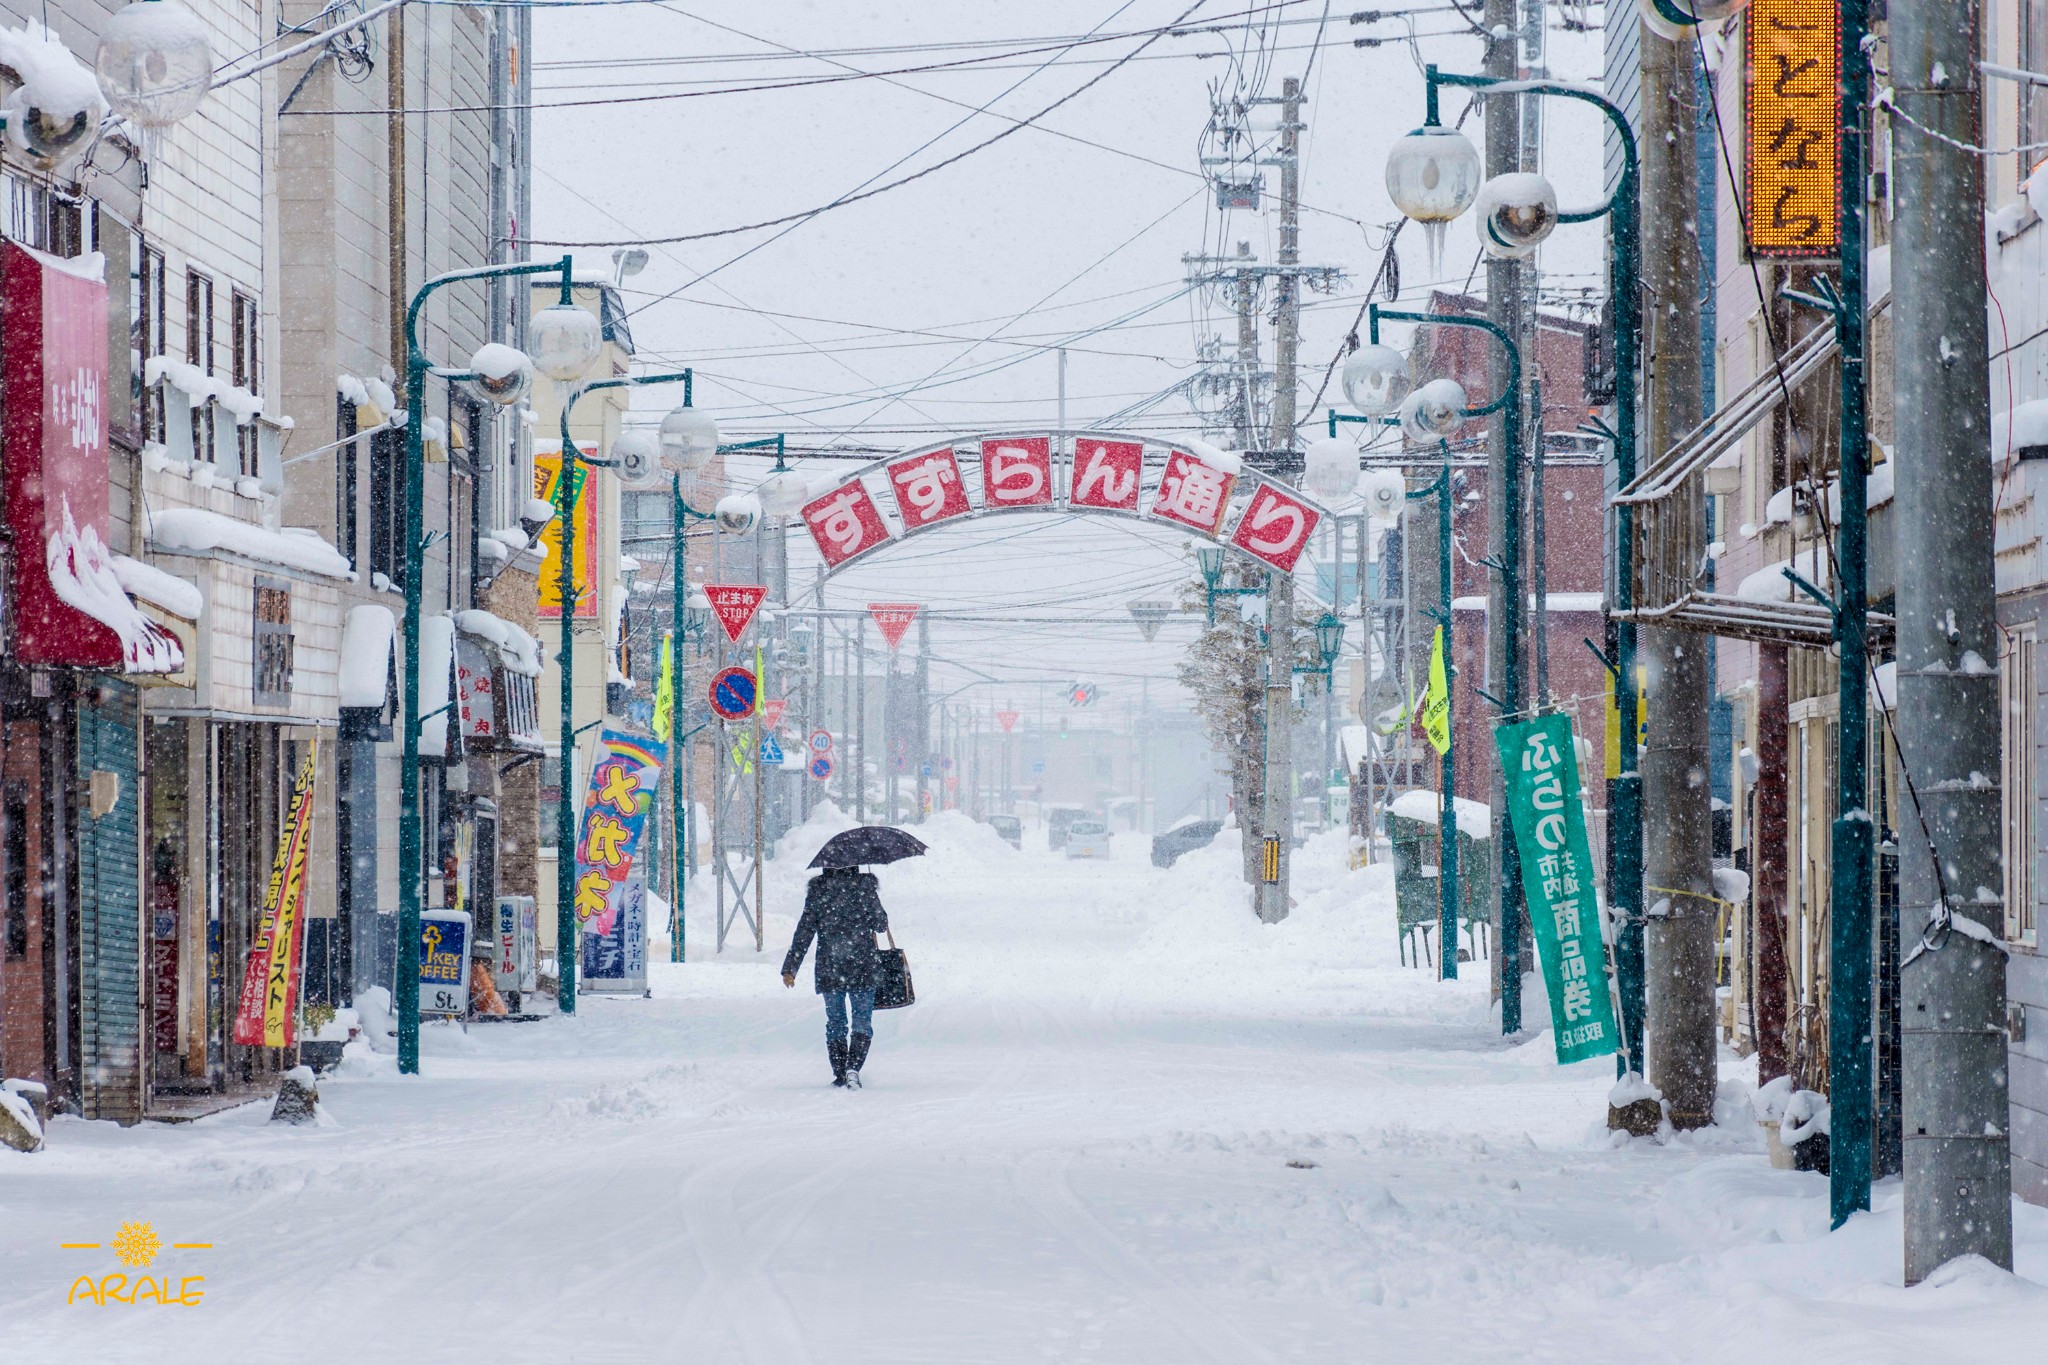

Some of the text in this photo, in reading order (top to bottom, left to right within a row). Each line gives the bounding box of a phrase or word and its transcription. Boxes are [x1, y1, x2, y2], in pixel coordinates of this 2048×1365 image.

[809, 445, 1306, 556] すずらん通り
[716, 592, 755, 605] 止まれ
[722, 607, 750, 619] STOP
[474, 677, 492, 735] 焼肉
[814, 736, 828, 748] 40
[574, 764, 640, 920] メガネ
[432, 952, 462, 966] KEY
[418, 964, 459, 980] OFFEE
[237, 957, 256, 1039] ください
[250, 958, 270, 1020] ご相談
[435, 991, 458, 1010] St.
